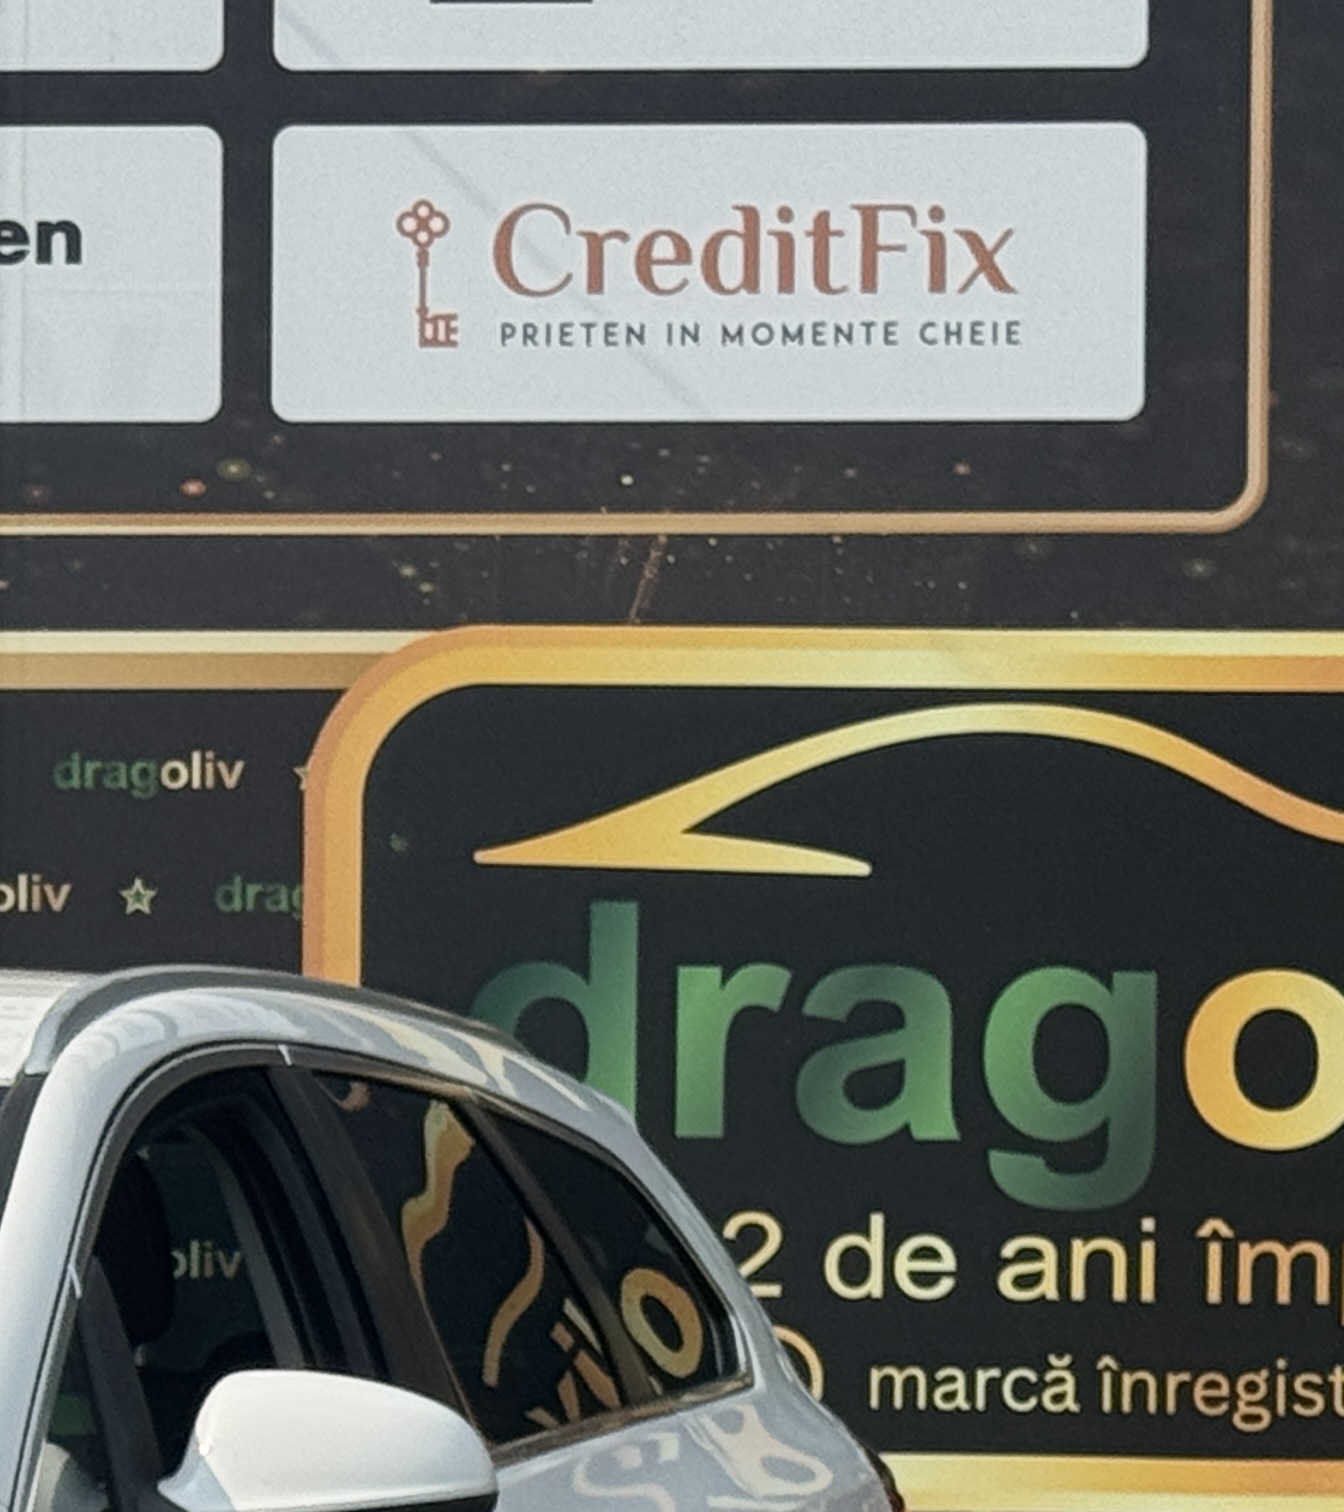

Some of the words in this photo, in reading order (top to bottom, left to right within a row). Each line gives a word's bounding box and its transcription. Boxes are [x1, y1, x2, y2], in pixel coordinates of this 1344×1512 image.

[491, 203, 1019, 297] CreditFix
[500, 321, 647, 347] PRIETEN
[667, 321, 701, 347] IN
[720, 321, 900, 347] MOMENTE
[918, 320, 1023, 347] CHEIE
[53, 752, 245, 798] dragoliv
[723, 1212, 784, 1298] 2
[823, 1213, 958, 1301] de
[997, 1217, 1156, 1304] ani
[1195, 1216, 1344, 1328] îm
[868, 1355, 1079, 1414] marcă
